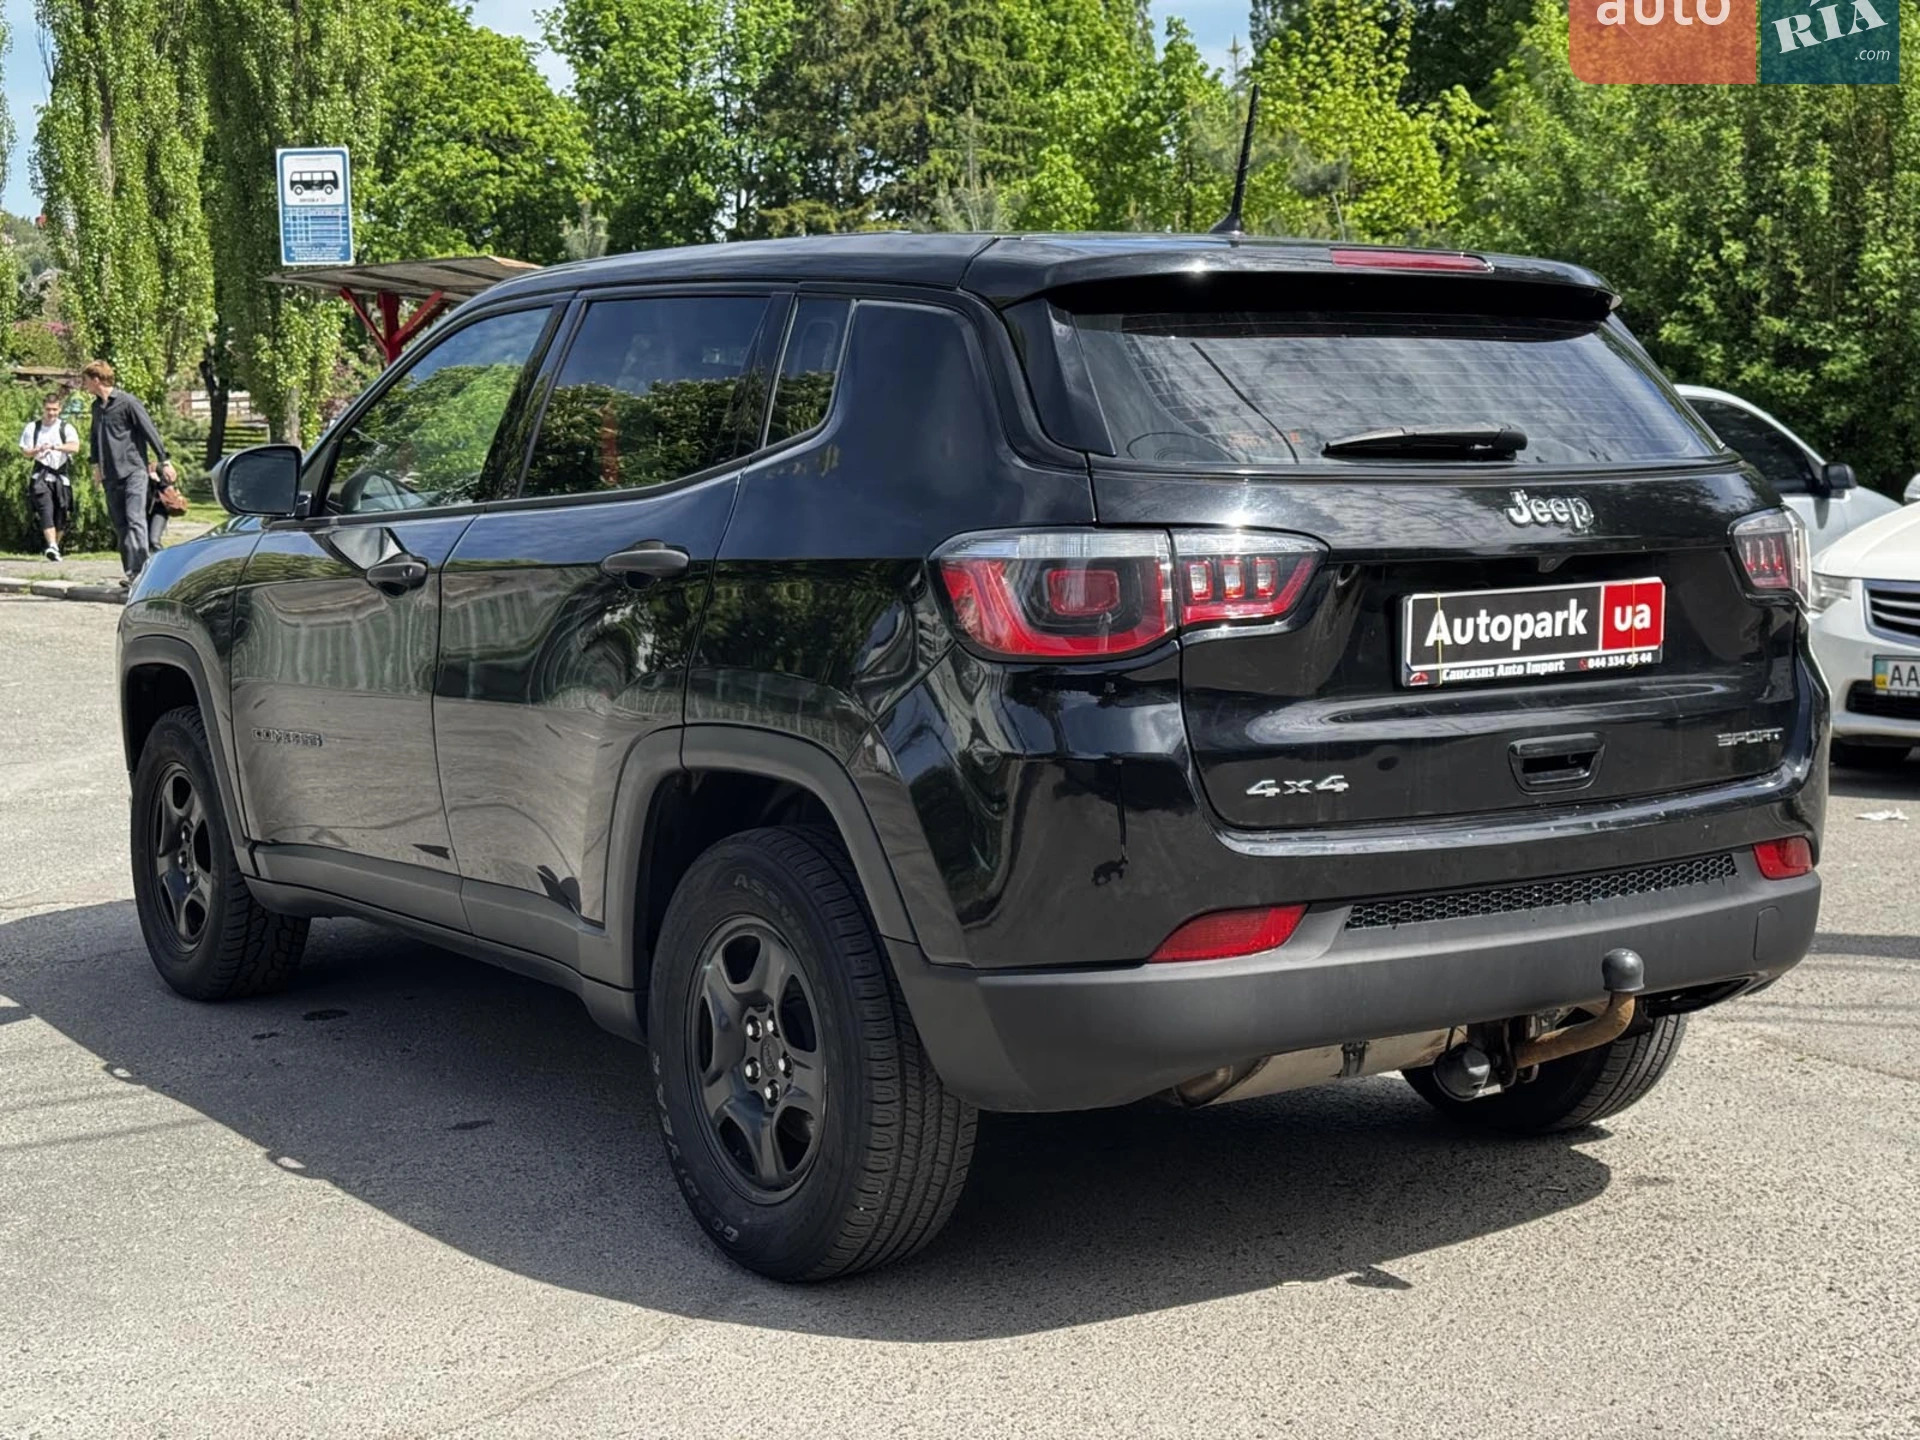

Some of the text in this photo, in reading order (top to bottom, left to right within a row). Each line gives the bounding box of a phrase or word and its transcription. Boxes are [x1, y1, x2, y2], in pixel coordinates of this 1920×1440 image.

[1504, 489, 1595, 532] Jeep
[1424, 598, 1651, 651] Autopark ua
[1442, 659, 1566, 681] Caucasus Auto Import
[1587, 656, 1606, 669] 044
[1607, 654, 1625, 667] 334
[1639, 651, 1653, 663] 44
[1889, 664, 1920, 687] AA
[1716, 726, 1784, 748] SPORT
